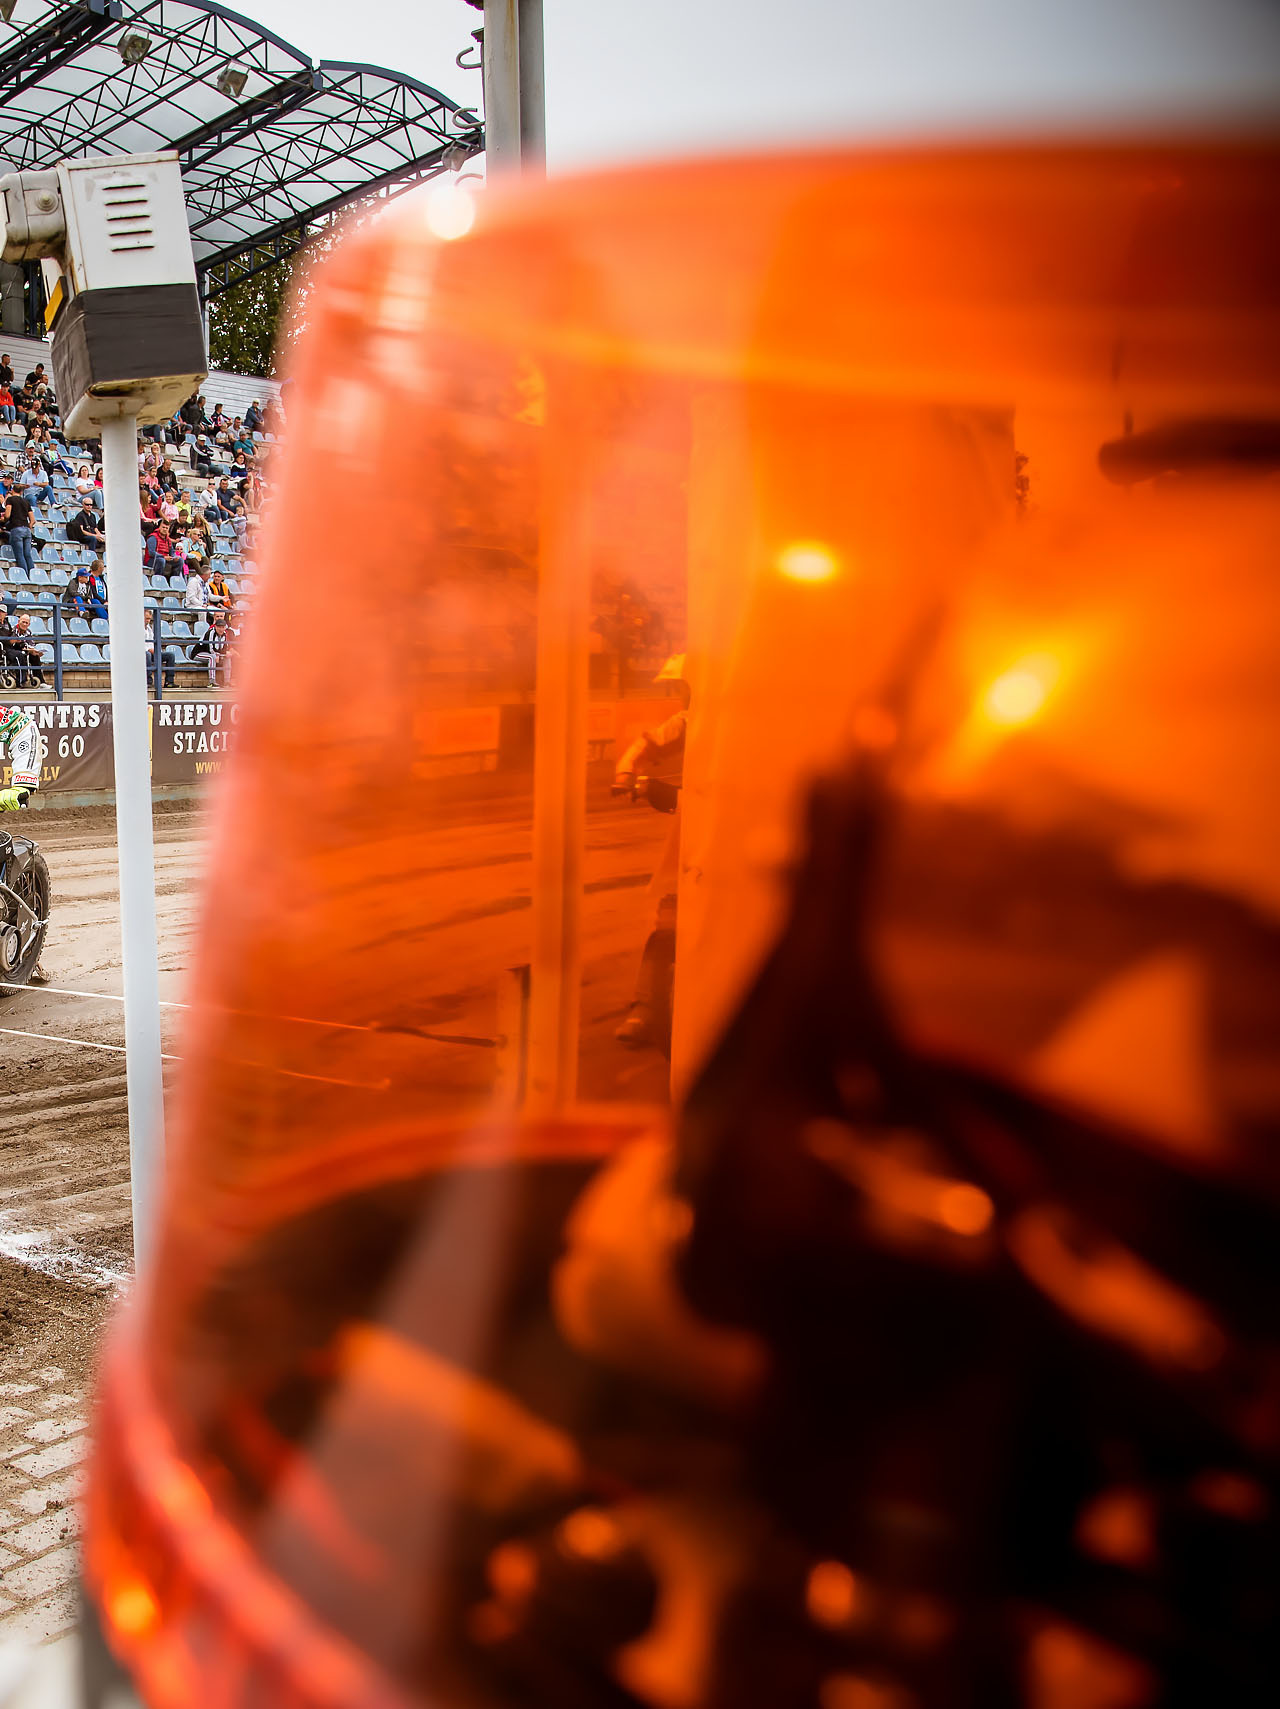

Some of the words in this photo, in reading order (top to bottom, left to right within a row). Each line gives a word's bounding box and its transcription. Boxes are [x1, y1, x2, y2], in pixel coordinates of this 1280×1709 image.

[9, 705, 100, 729] ENTRS
[159, 704, 223, 726] RIEPU
[58, 734, 85, 758] 60
[173, 731, 236, 754] STACI
